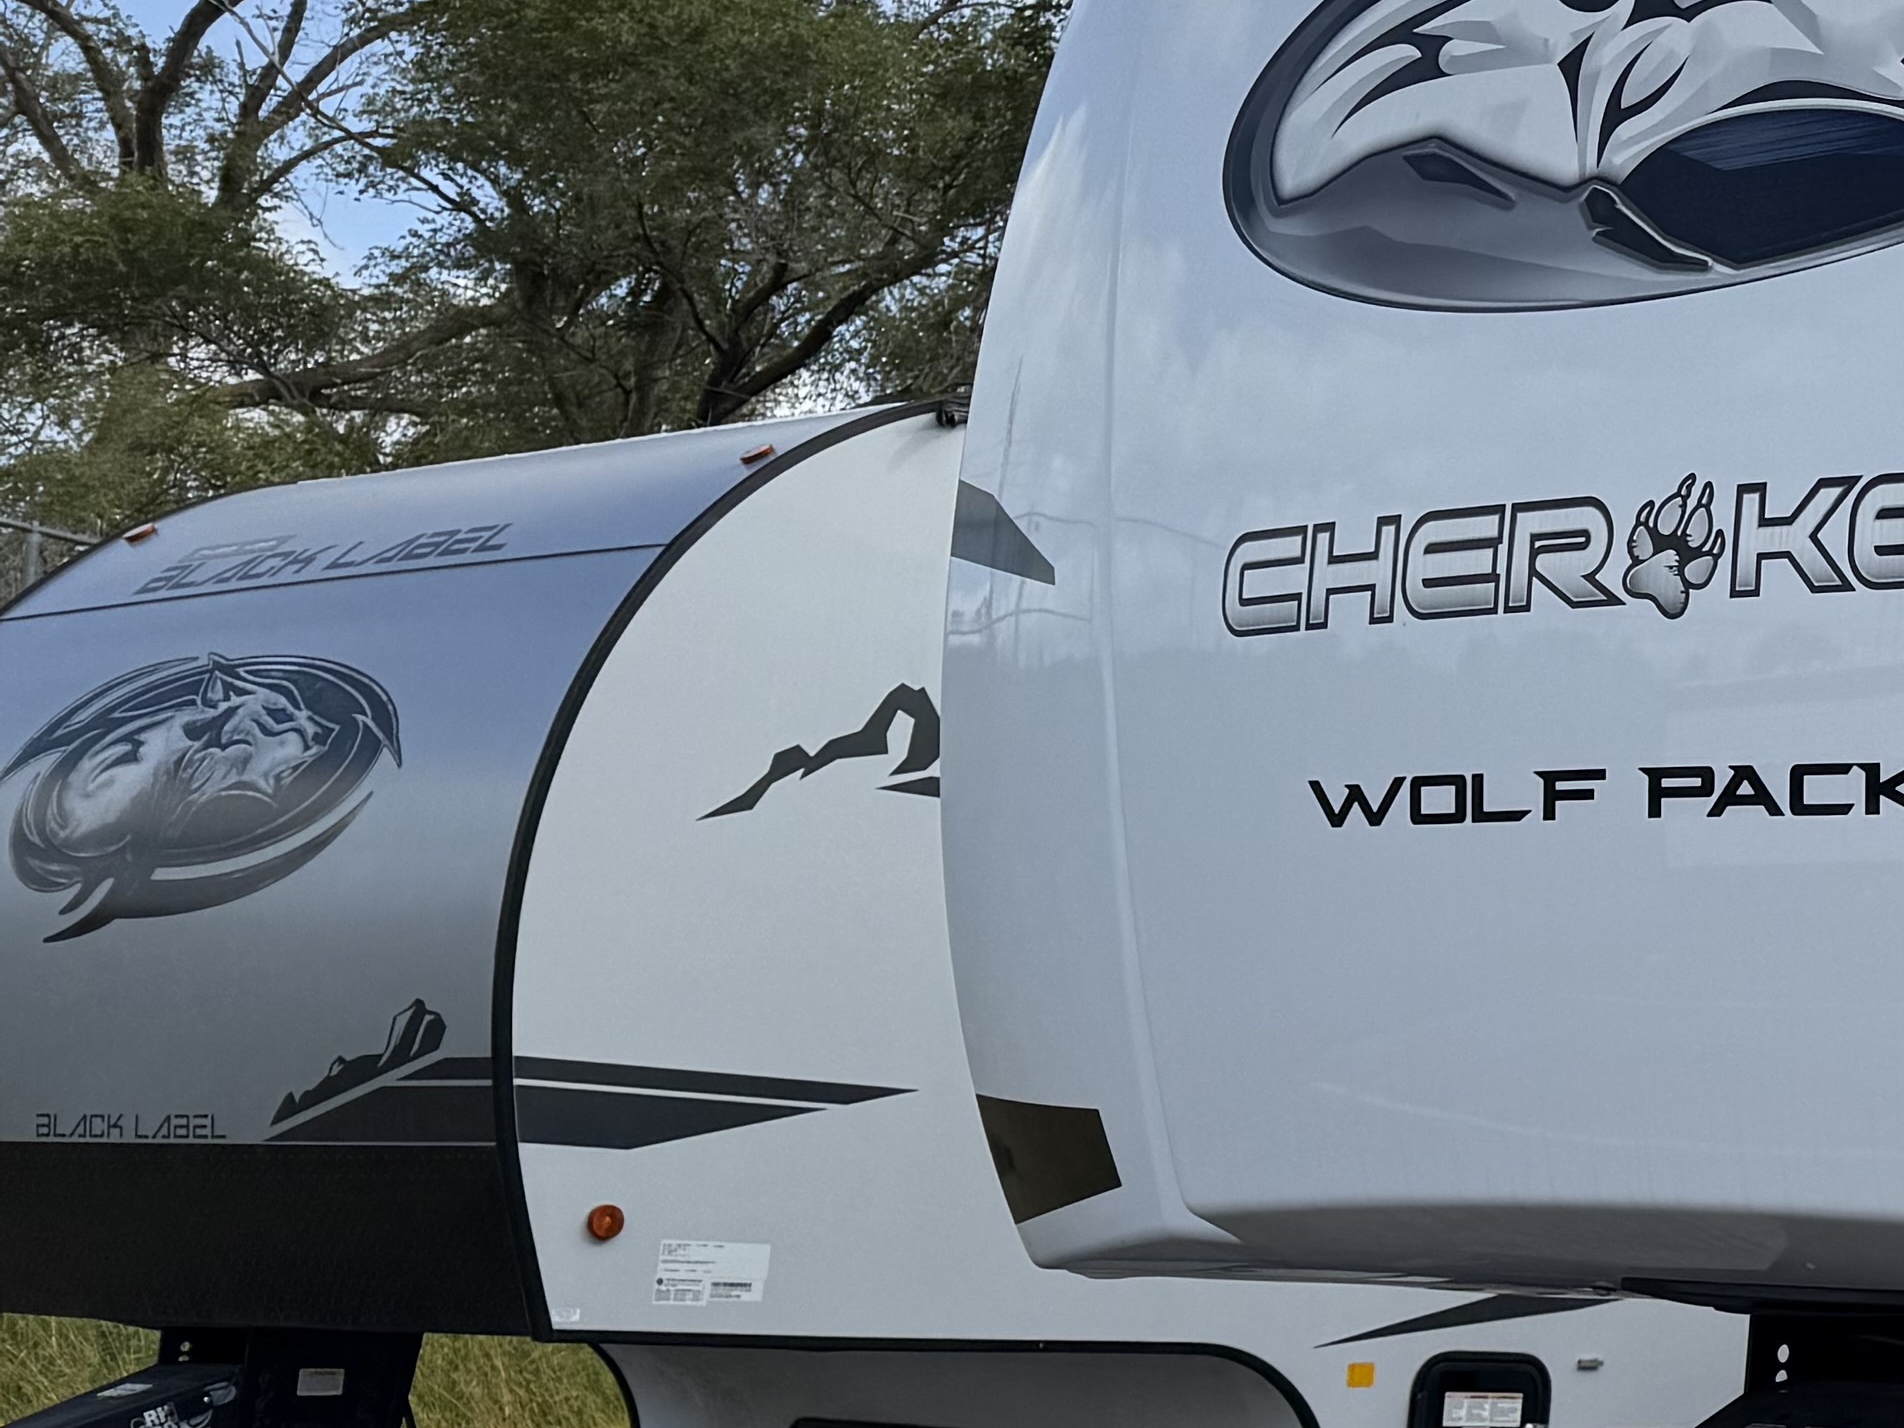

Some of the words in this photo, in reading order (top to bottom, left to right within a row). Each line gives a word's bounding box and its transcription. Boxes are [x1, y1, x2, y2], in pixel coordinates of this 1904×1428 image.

[131, 542, 338, 597] BLACK
[323, 522, 514, 571] LABEL
[1307, 766, 1607, 829] WOLF
[36, 1113, 124, 1139] BLACK
[134, 1113, 227, 1140] LABEL
